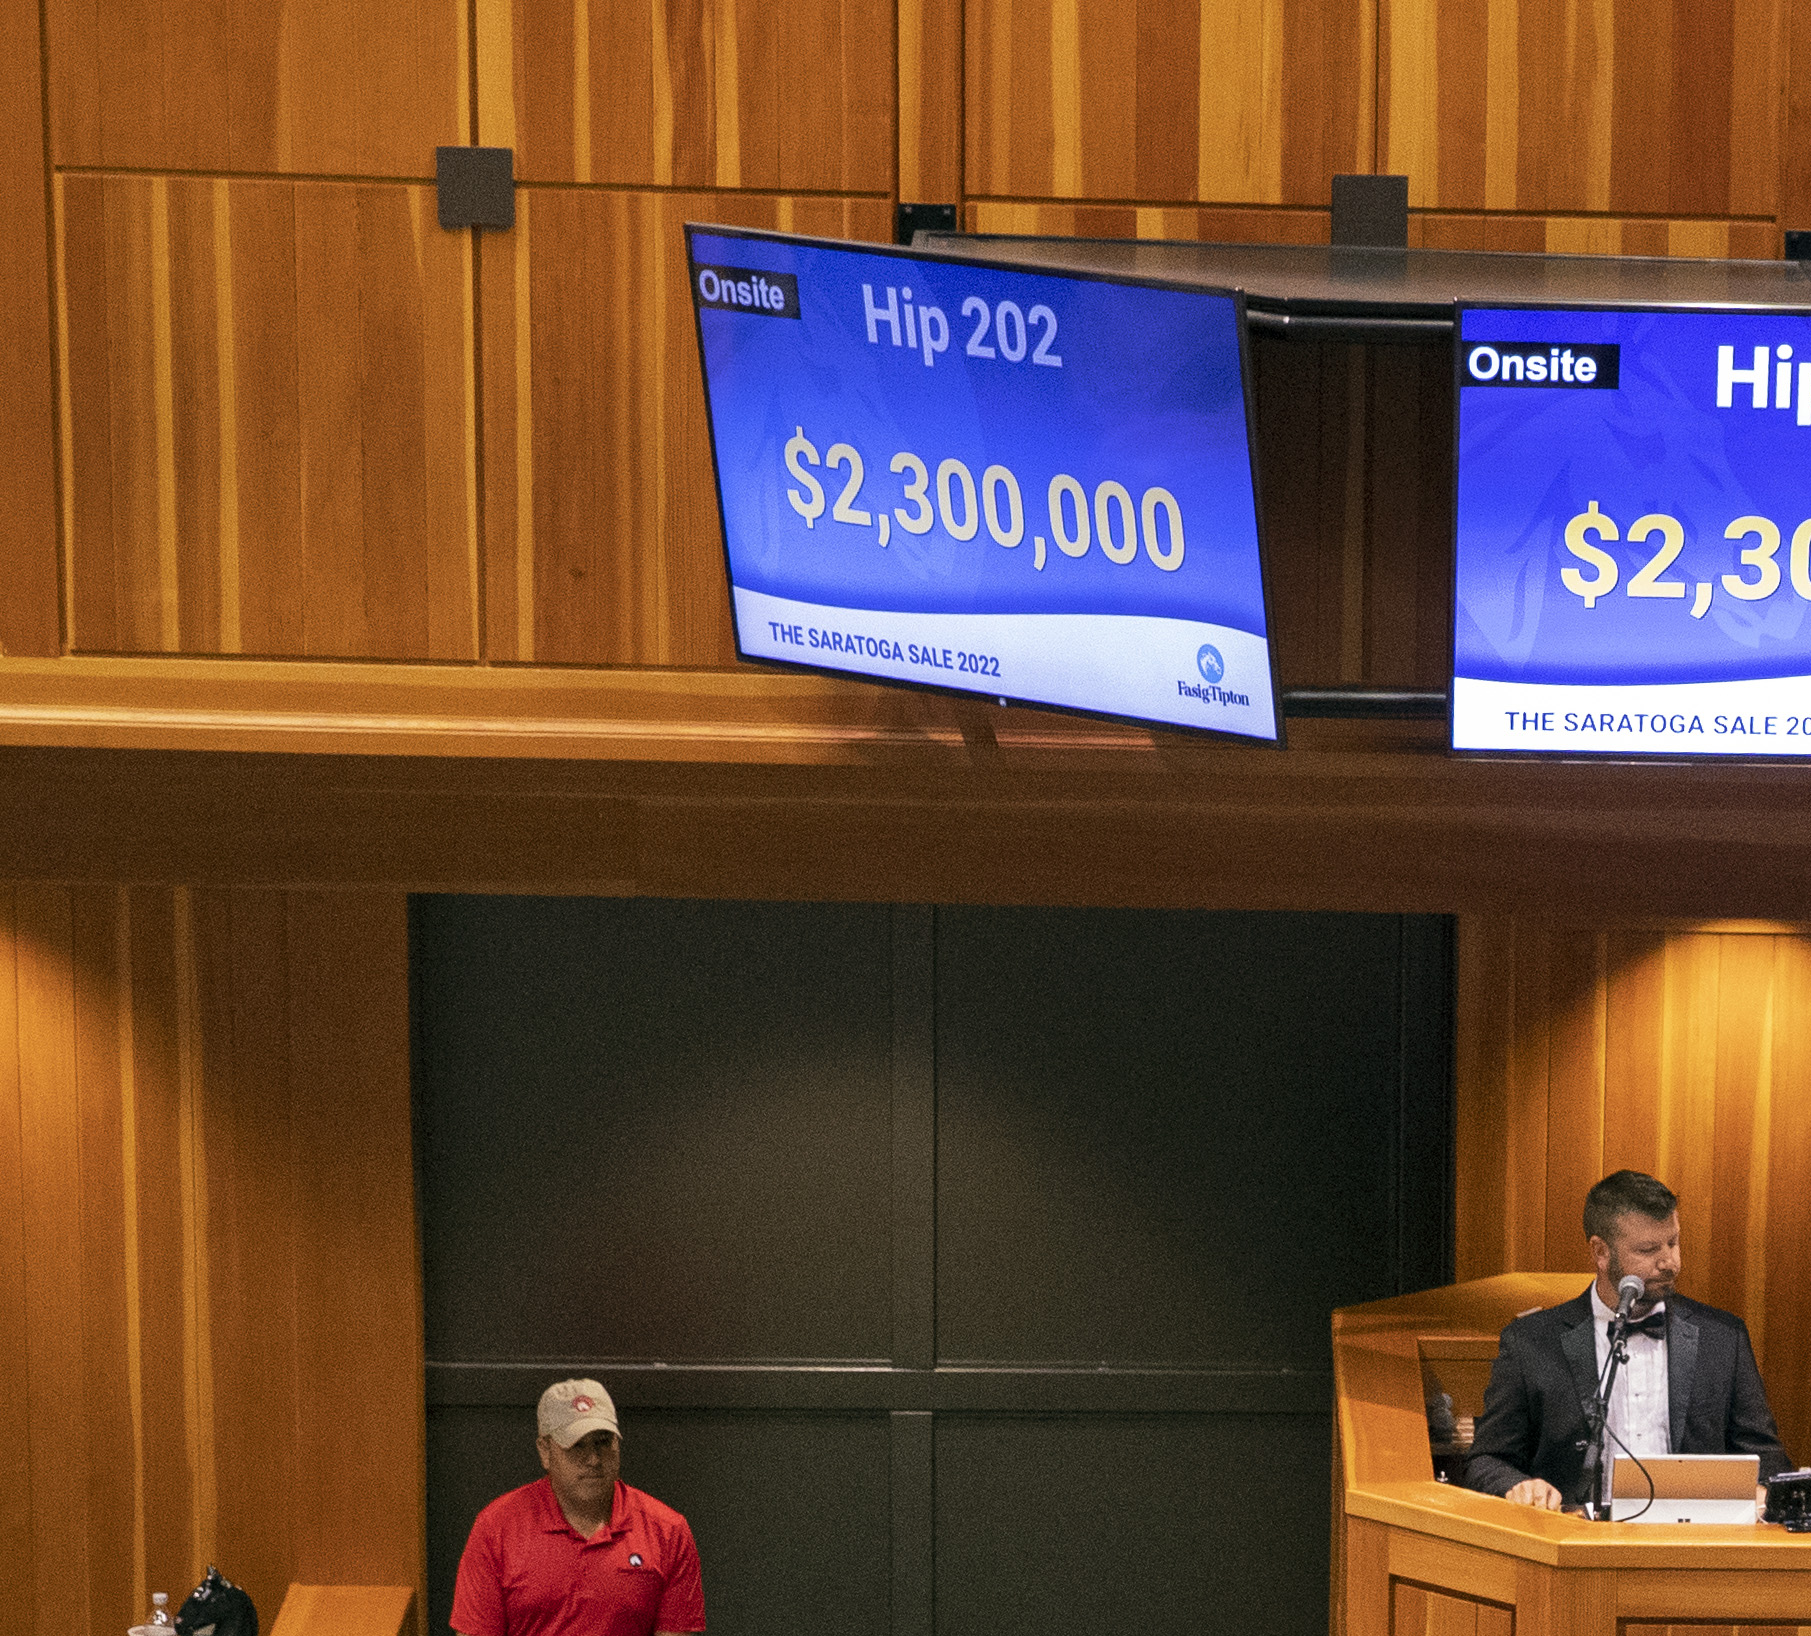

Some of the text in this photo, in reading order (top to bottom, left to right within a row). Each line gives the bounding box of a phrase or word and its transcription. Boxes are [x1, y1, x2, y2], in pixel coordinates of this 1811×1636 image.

[699, 269, 784, 311] Onsite
[862, 283, 1063, 367] Hip 202
[1467, 345, 1597, 383] Onsite
[783, 426, 1185, 571] $2,300,000
[768, 621, 1001, 677] THE SARATOGA SALE 2022
[1505, 711, 1554, 732] THE
[1564, 713, 1704, 734] SARATOGA
[1714, 715, 1777, 735] SALE
